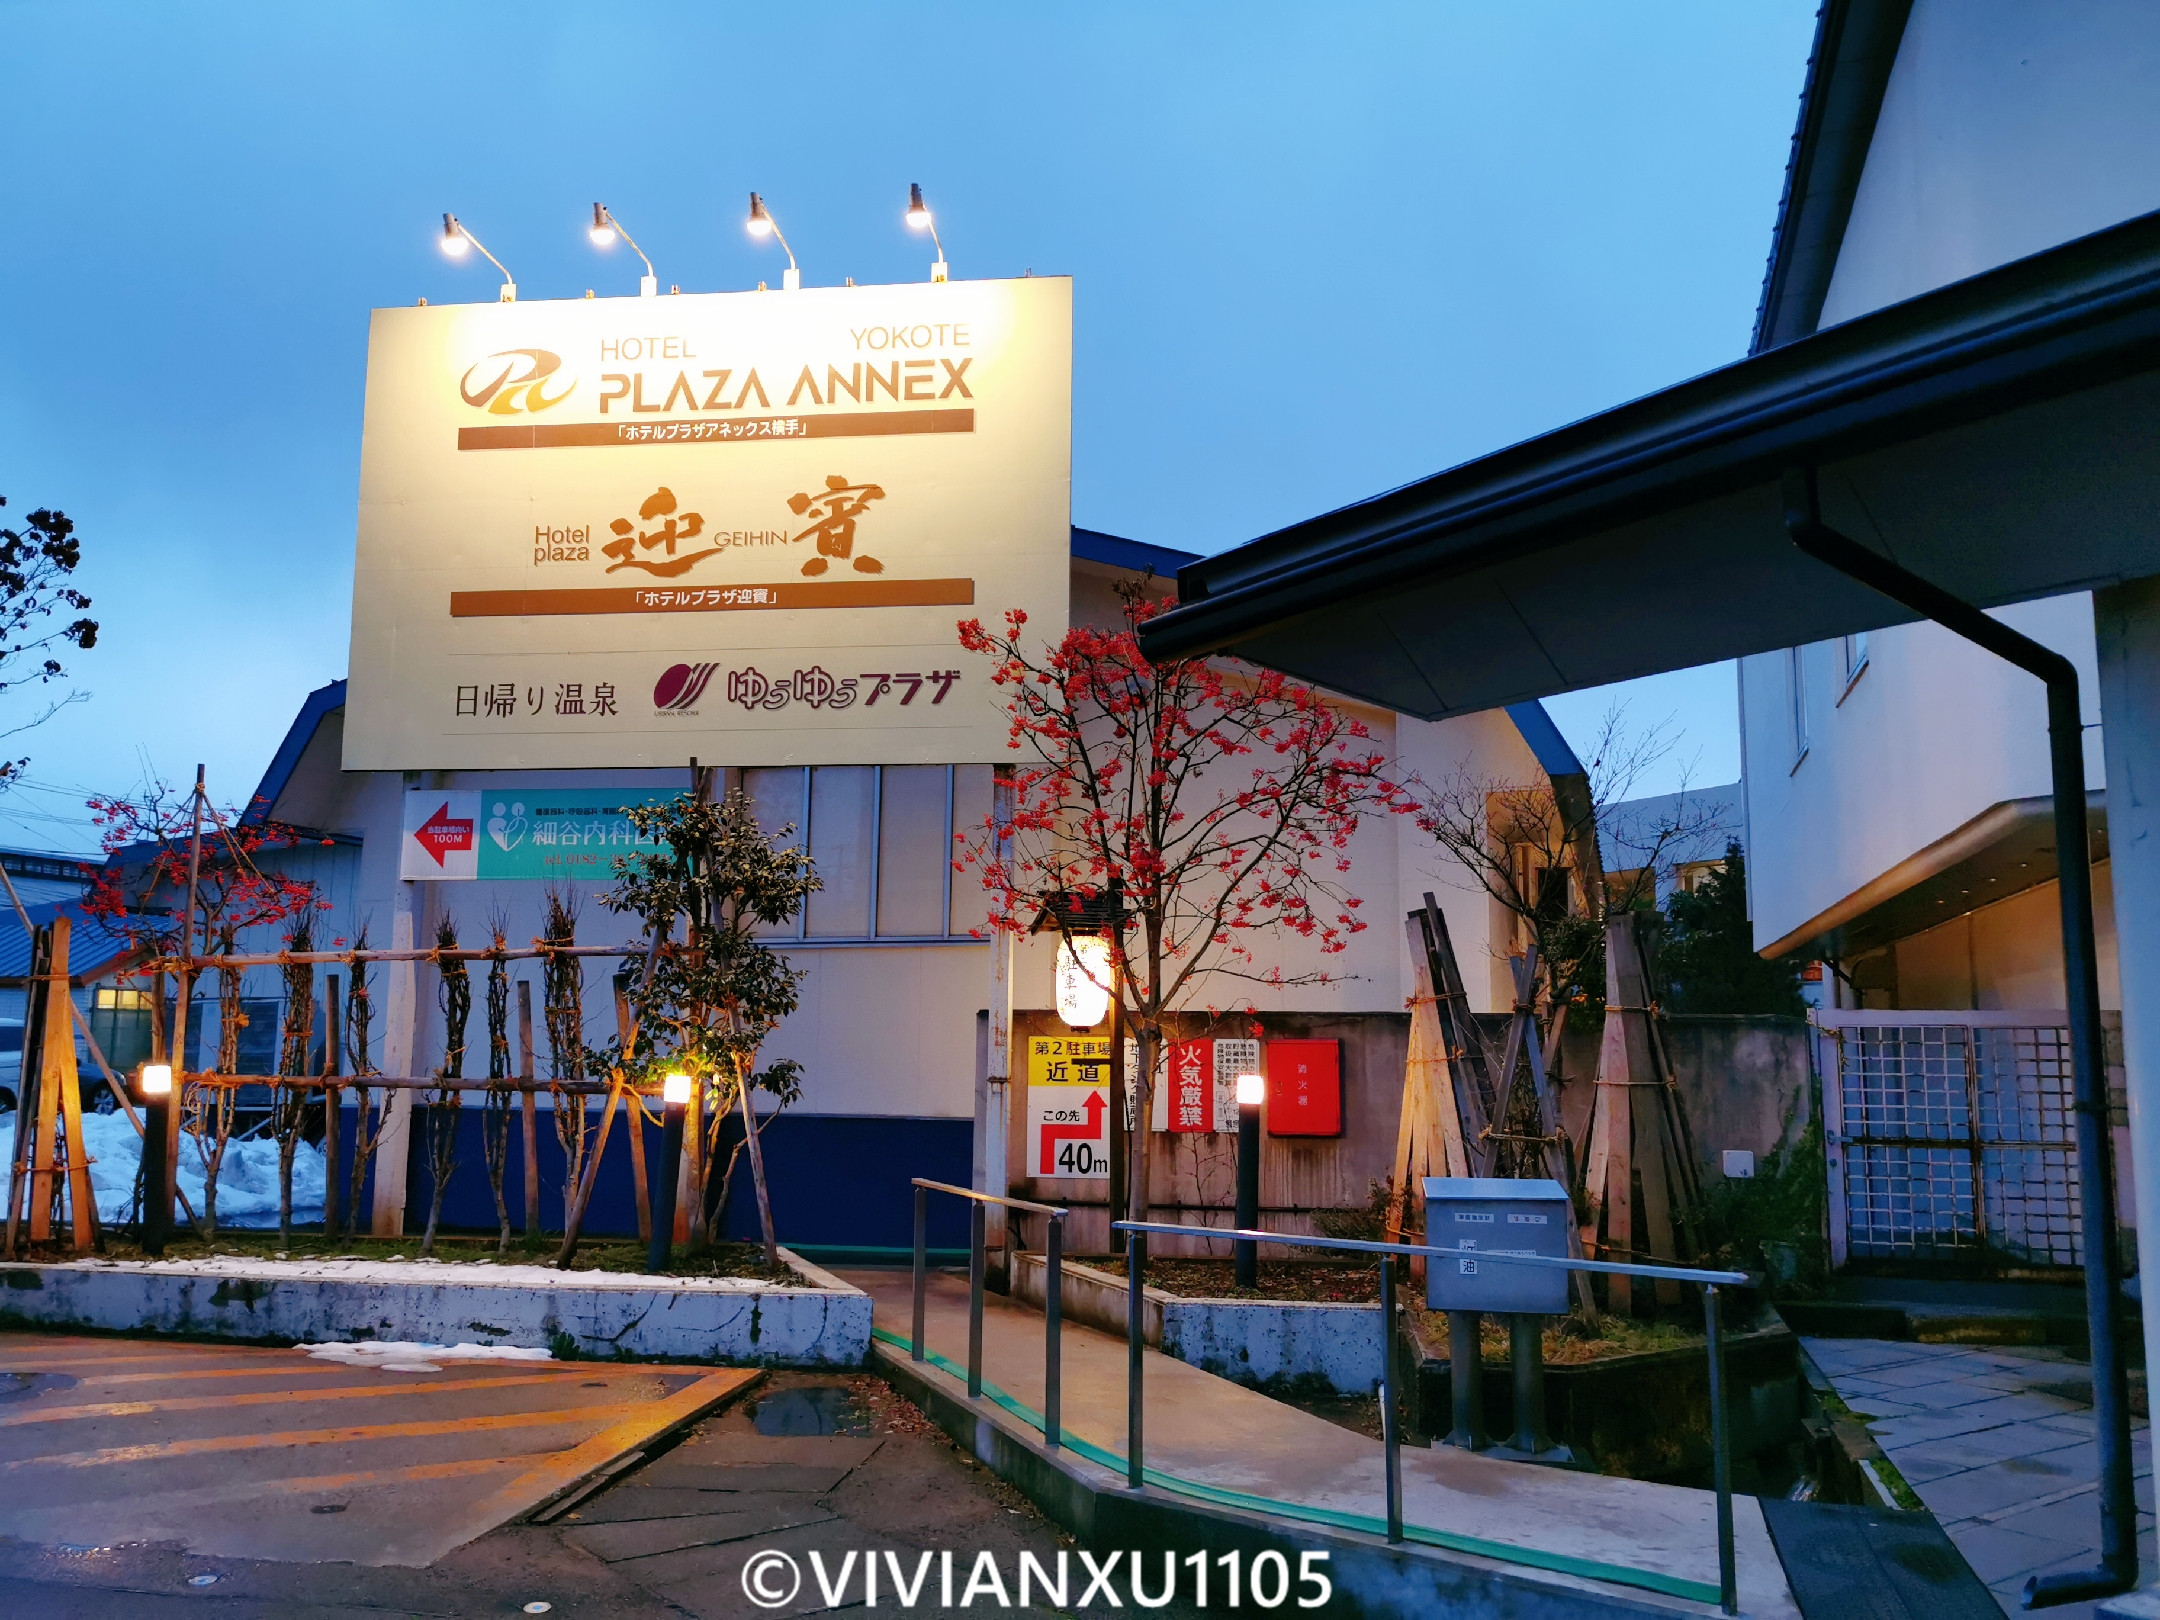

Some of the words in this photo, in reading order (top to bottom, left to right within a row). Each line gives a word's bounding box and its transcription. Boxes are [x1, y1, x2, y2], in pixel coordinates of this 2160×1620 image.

[601, 336, 697, 361] HOTEL
[850, 323, 970, 350] YOKOTE
[600, 367, 770, 413] PLAZA
[786, 358, 974, 405] ANNEX
[535, 525, 590, 545] Hotel
[714, 530, 788, 547] GEIHIN
[534, 543, 590, 567] plaza
[455, 681, 618, 718] 日帰り温泉
[727, 666, 961, 711] ゆうゆうプラザ
[434, 834, 463, 844] 100M
[532, 819, 668, 846] 細谷内科医
[1035, 1041, 1111, 1056] 第2駐車場
[1046, 1060, 1100, 1083] 近道
[1179, 1045, 1203, 1127] 火気厳禁
[1043, 1110, 1080, 1122] この先
[1058, 1142, 1108, 1175] 40m
